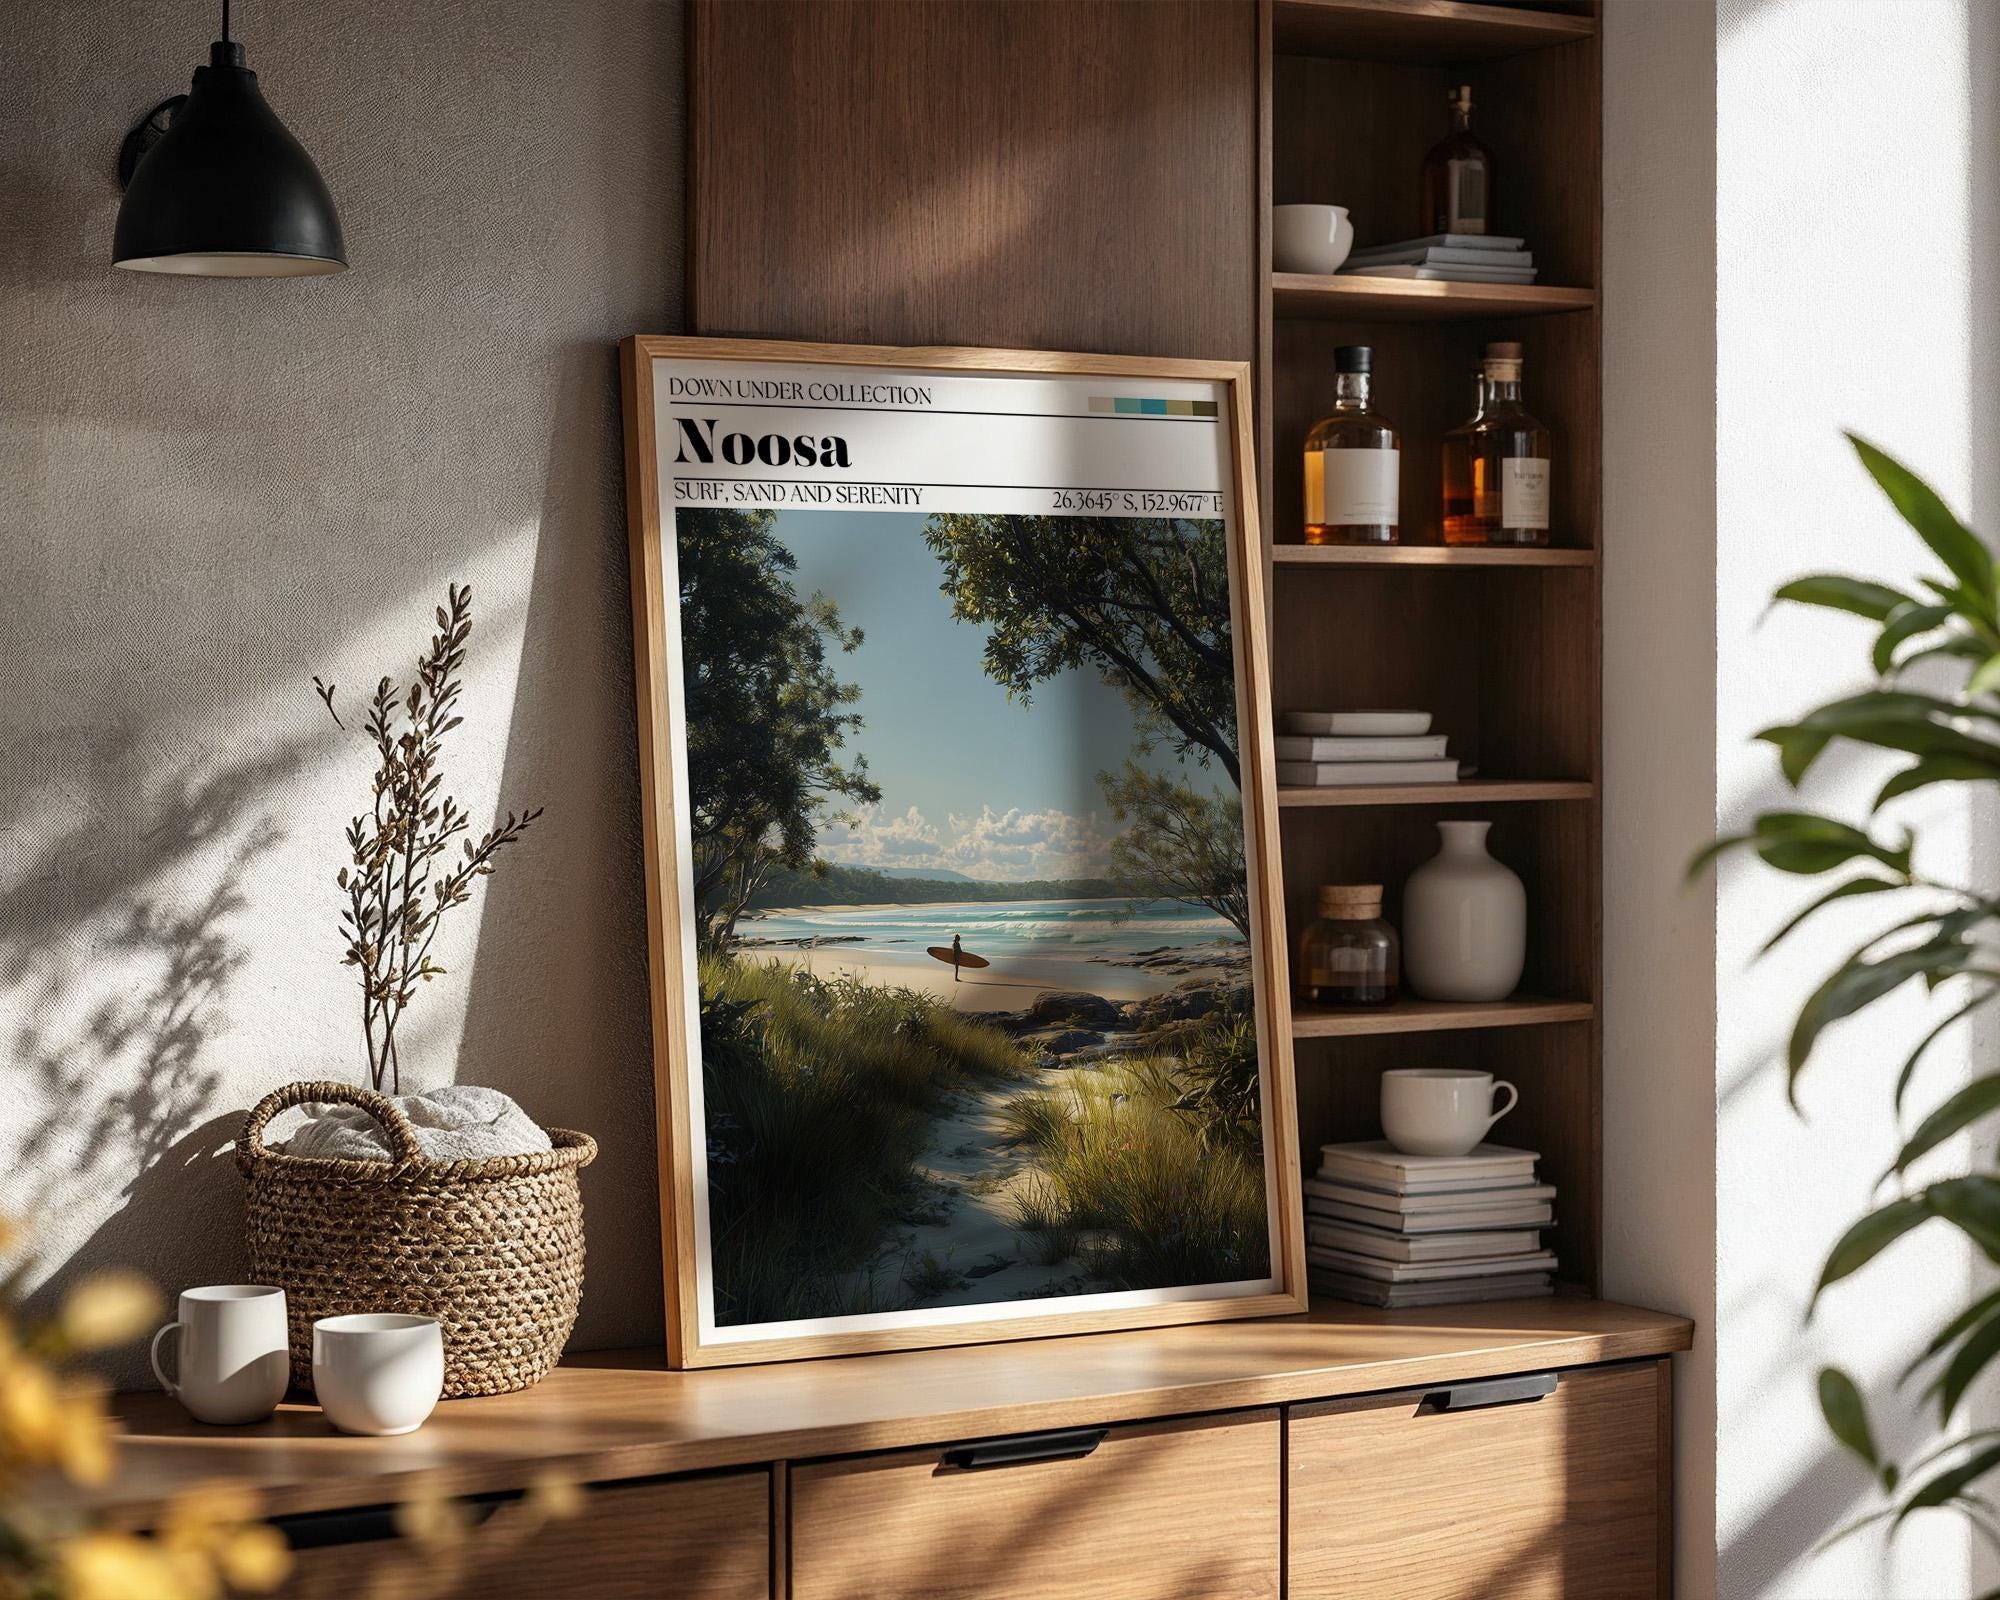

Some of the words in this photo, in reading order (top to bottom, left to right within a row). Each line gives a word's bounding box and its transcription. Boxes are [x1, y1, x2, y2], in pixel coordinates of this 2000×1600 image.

[669, 377, 733, 397] DOWN
[737, 380, 804, 400] UNDER
[808, 382, 932, 405] COLLECTION
[672, 417, 853, 468] Noosa
[674, 482, 729, 502] SURF,
[733, 483, 786, 502] SAND
[790, 485, 832, 503] AND
[836, 486, 923, 505] SERENITY
[1052, 490, 1120, 512] 26.3645°
[1213, 495, 1224, 512] E
